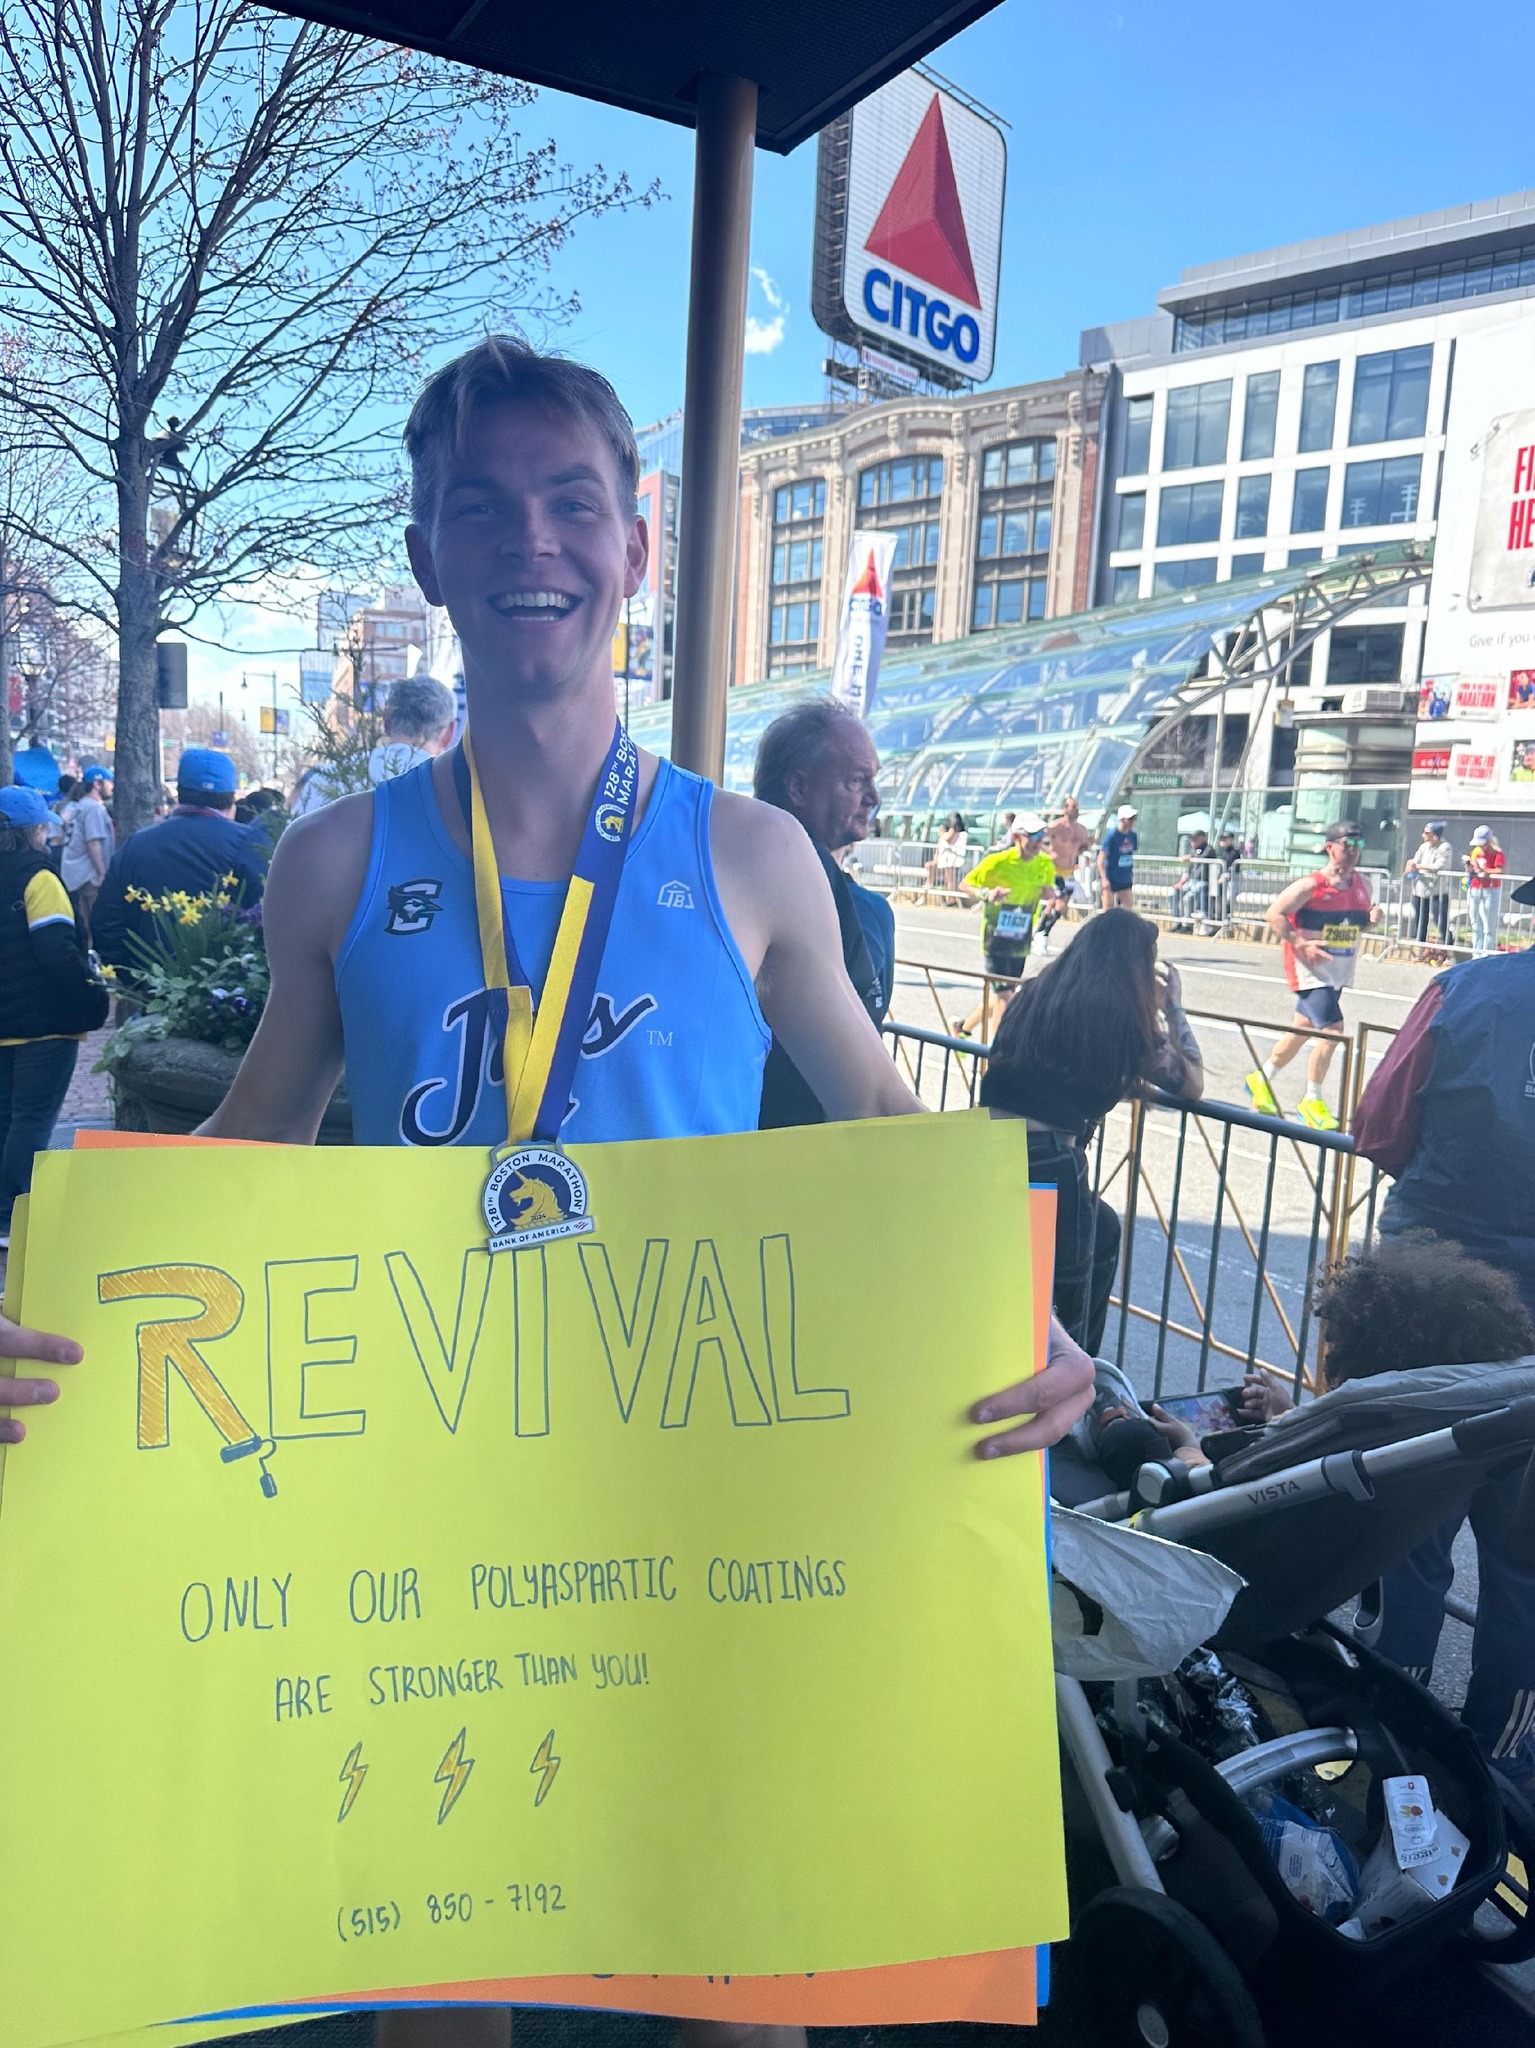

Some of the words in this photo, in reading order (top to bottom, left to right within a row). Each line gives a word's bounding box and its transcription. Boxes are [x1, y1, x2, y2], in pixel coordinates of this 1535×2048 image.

[864, 268, 980, 363] CITGO
[1514, 445, 1535, 494] FI
[1469, 633, 1494, 648] Give
[1508, 633, 1530, 648] you
[1456, 692, 1496, 708] MARATHON
[617, 738, 637, 806] MARAT
[1137, 774, 1179, 786] KENMORE
[490, 1154, 530, 1192] BOSTON
[538, 1153, 583, 1209] MARATHON
[488, 1196, 502, 1228] 128TH
[531, 1213, 547, 1221] 2024
[492, 1237, 516, 1248] BANK
[519, 1234, 530, 1243] OF
[532, 1225, 571, 1240] AMERICA
[97, 1233, 851, 1451] REVIVAL
[1247, 1480, 1301, 1504] VISTA
[181, 1572, 292, 1642] ONLY
[349, 1567, 421, 1624] OUR
[470, 1555, 677, 1610] POLYASPARTIC
[708, 1555, 847, 1603] COATINGS
[276, 1675, 332, 1721] ARE
[368, 1658, 504, 1705] STRONGER
[514, 1652, 578, 1686] THAN
[591, 1652, 650, 1689] YOU!
[337, 1901, 401, 1942] (515)
[426, 1893, 473, 1924] 850
[507, 1883, 567, 1914] 7192
